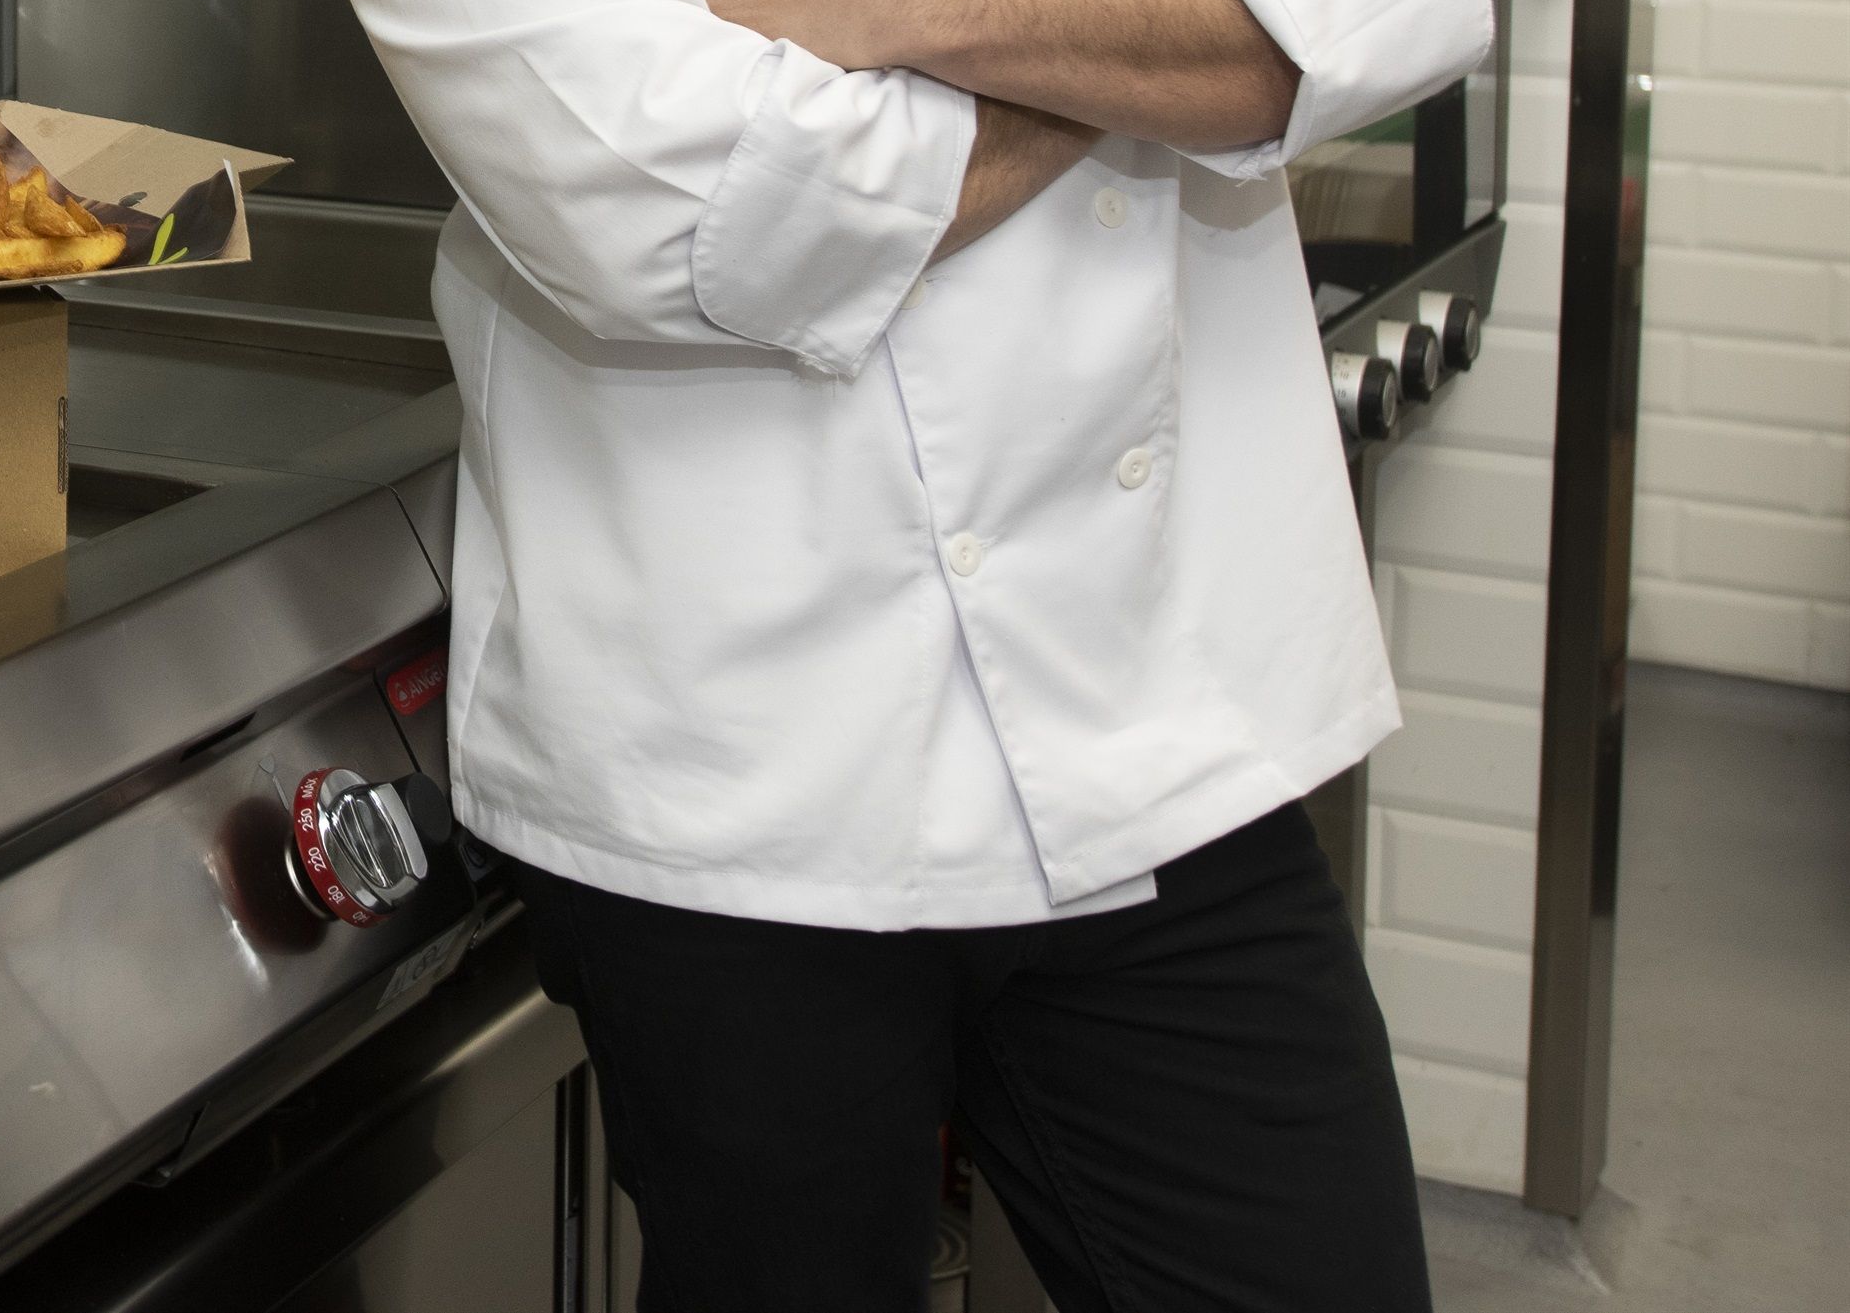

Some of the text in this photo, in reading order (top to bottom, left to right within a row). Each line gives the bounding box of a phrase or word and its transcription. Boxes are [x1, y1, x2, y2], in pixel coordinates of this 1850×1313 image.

[302, 807, 315, 832] 250
[308, 847, 327, 873] 220
[327, 885, 346, 904] 180
